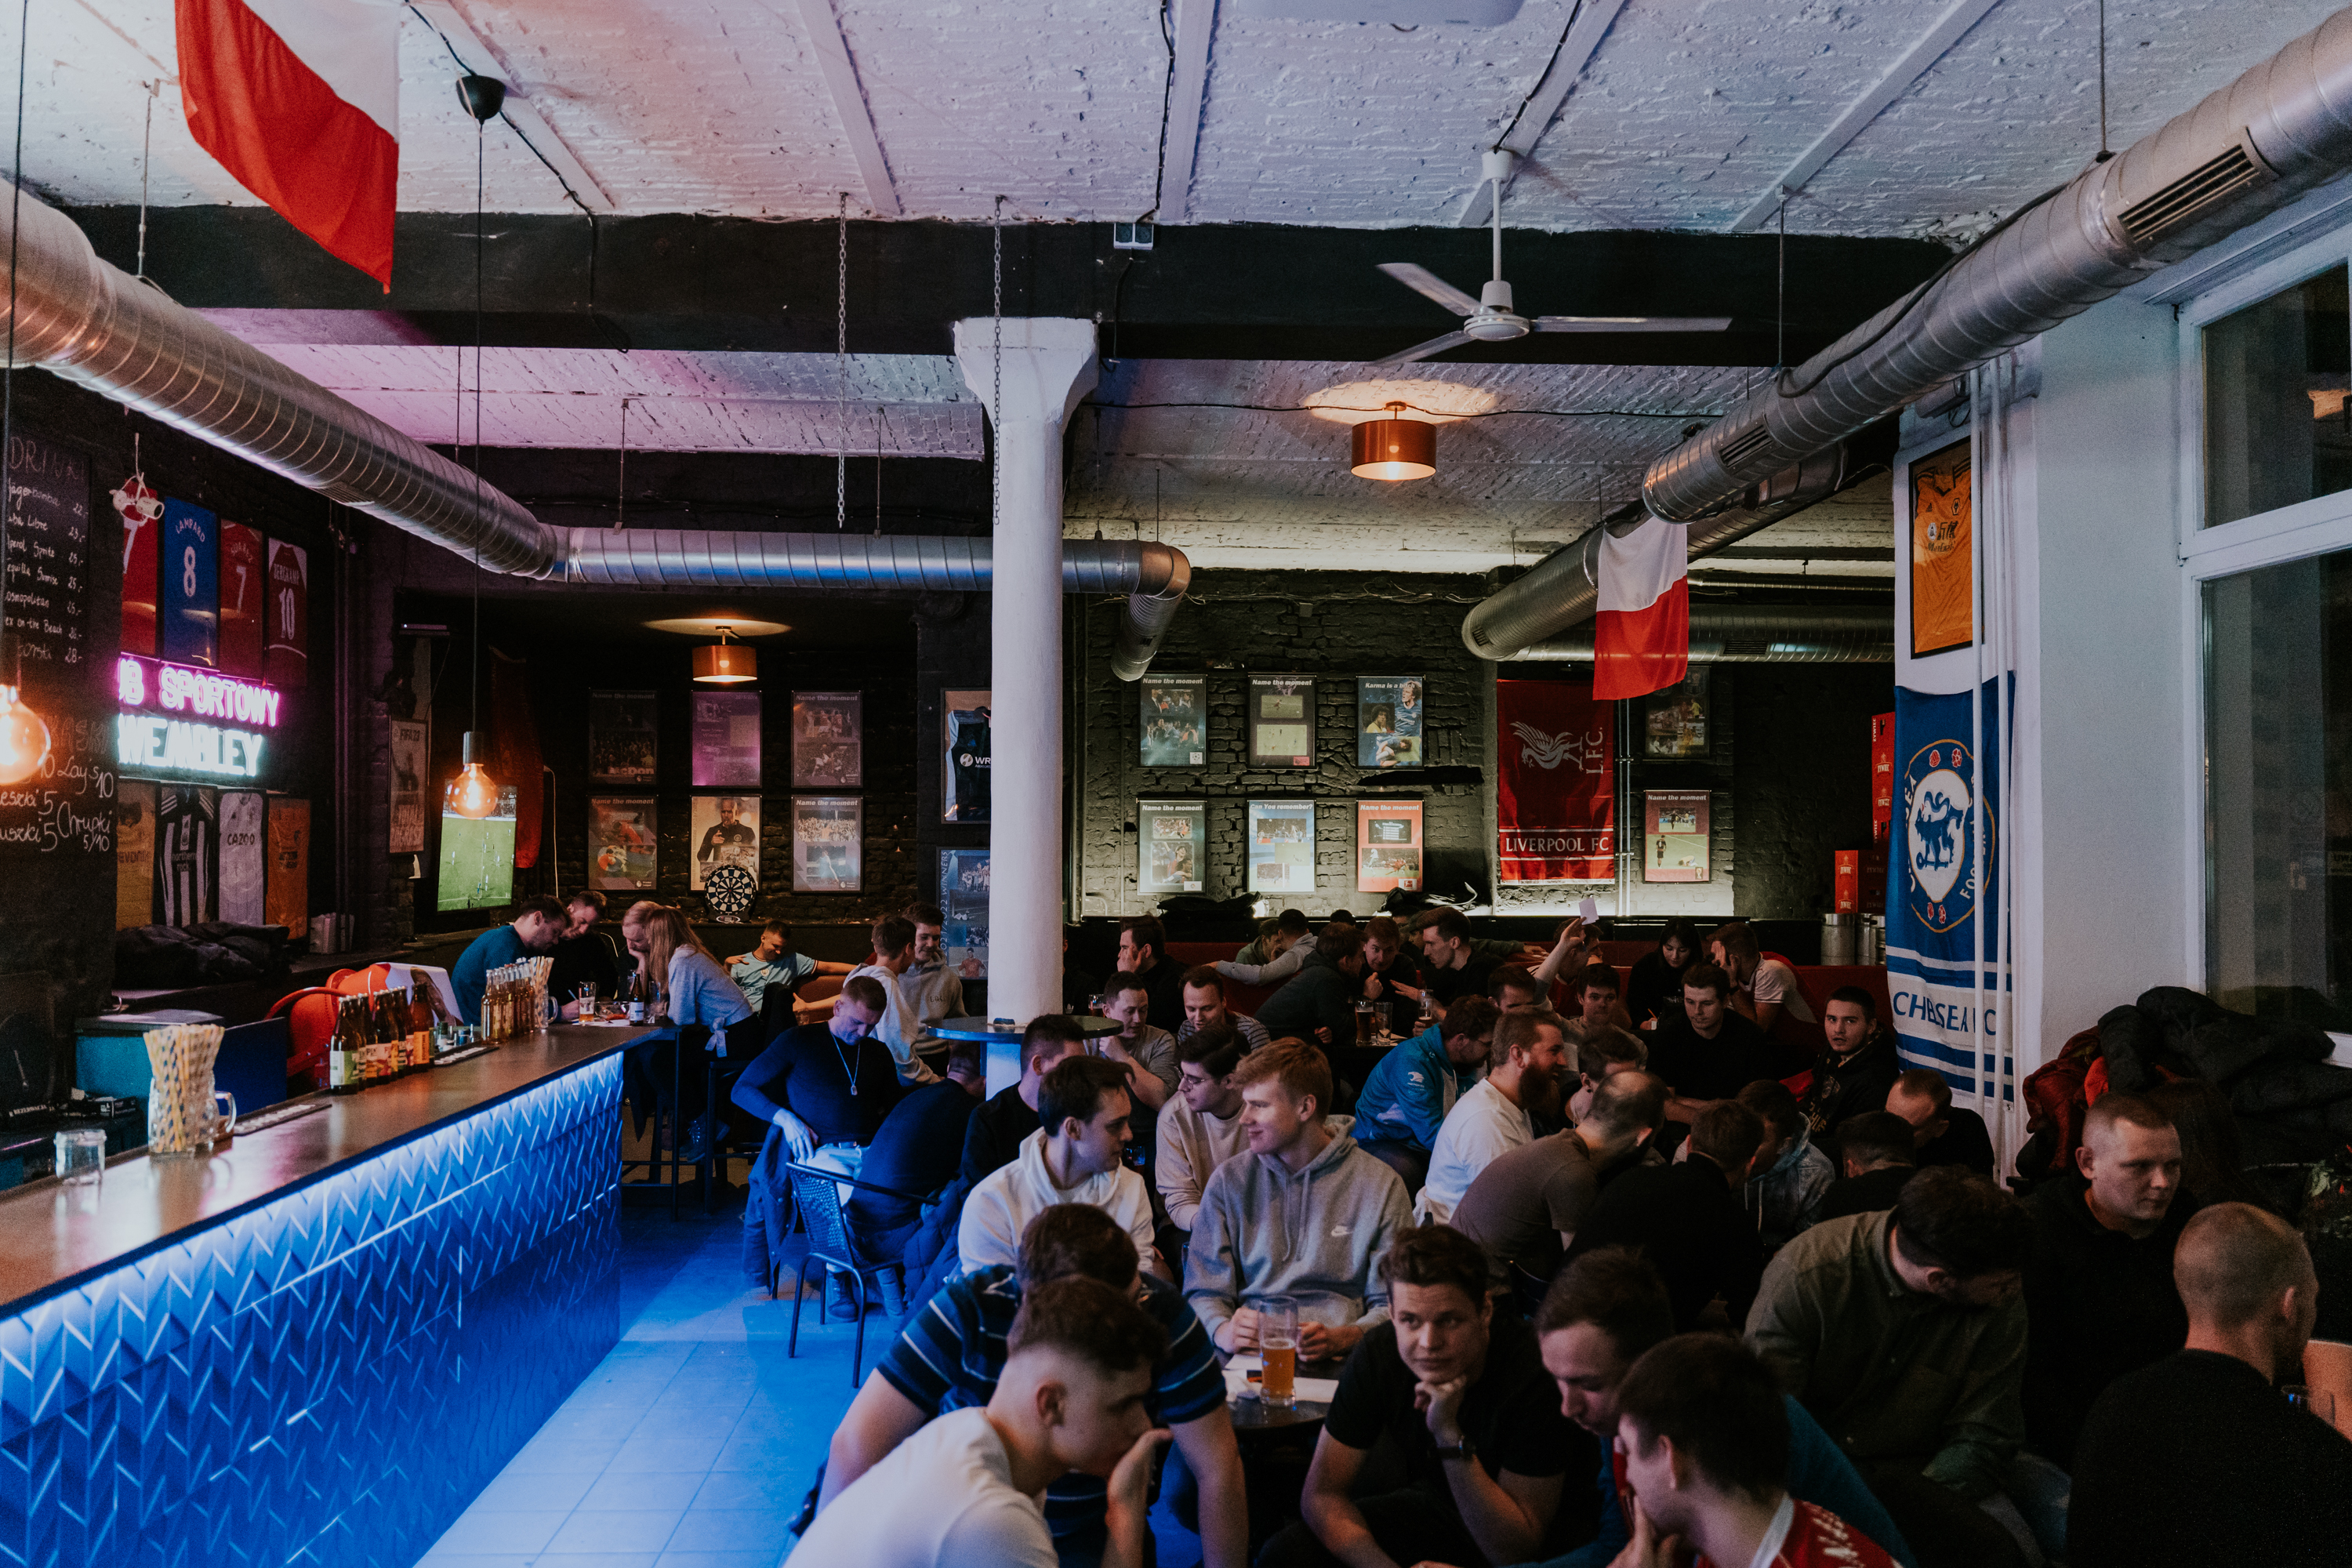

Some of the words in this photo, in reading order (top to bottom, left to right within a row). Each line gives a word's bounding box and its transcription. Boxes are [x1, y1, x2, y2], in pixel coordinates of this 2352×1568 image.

[7, 533, 27, 553] perol
[175, 517, 207, 543] LAMPARD
[182, 546, 196, 597] 8
[5, 590, 49, 609] osmopolitan
[236, 564, 247, 612] 7
[43, 619, 63, 634] Beach
[278, 587, 296, 641] 10
[159, 665, 280, 728] SPORTOWY
[117, 713, 263, 778] WEMBLEY
[1585, 727, 1604, 775] L.F.C.
[57, 755, 100, 795] Lay's
[96, 771, 114, 799] 10
[38, 790, 58, 815] 5
[41, 822, 58, 852] 5
[227, 833, 255, 846] CAZOO
[1505, 837, 1585, 852] LIVERPOOL
[1591, 837, 1610, 851] FC
[1973, 1007, 1997, 1036] C
